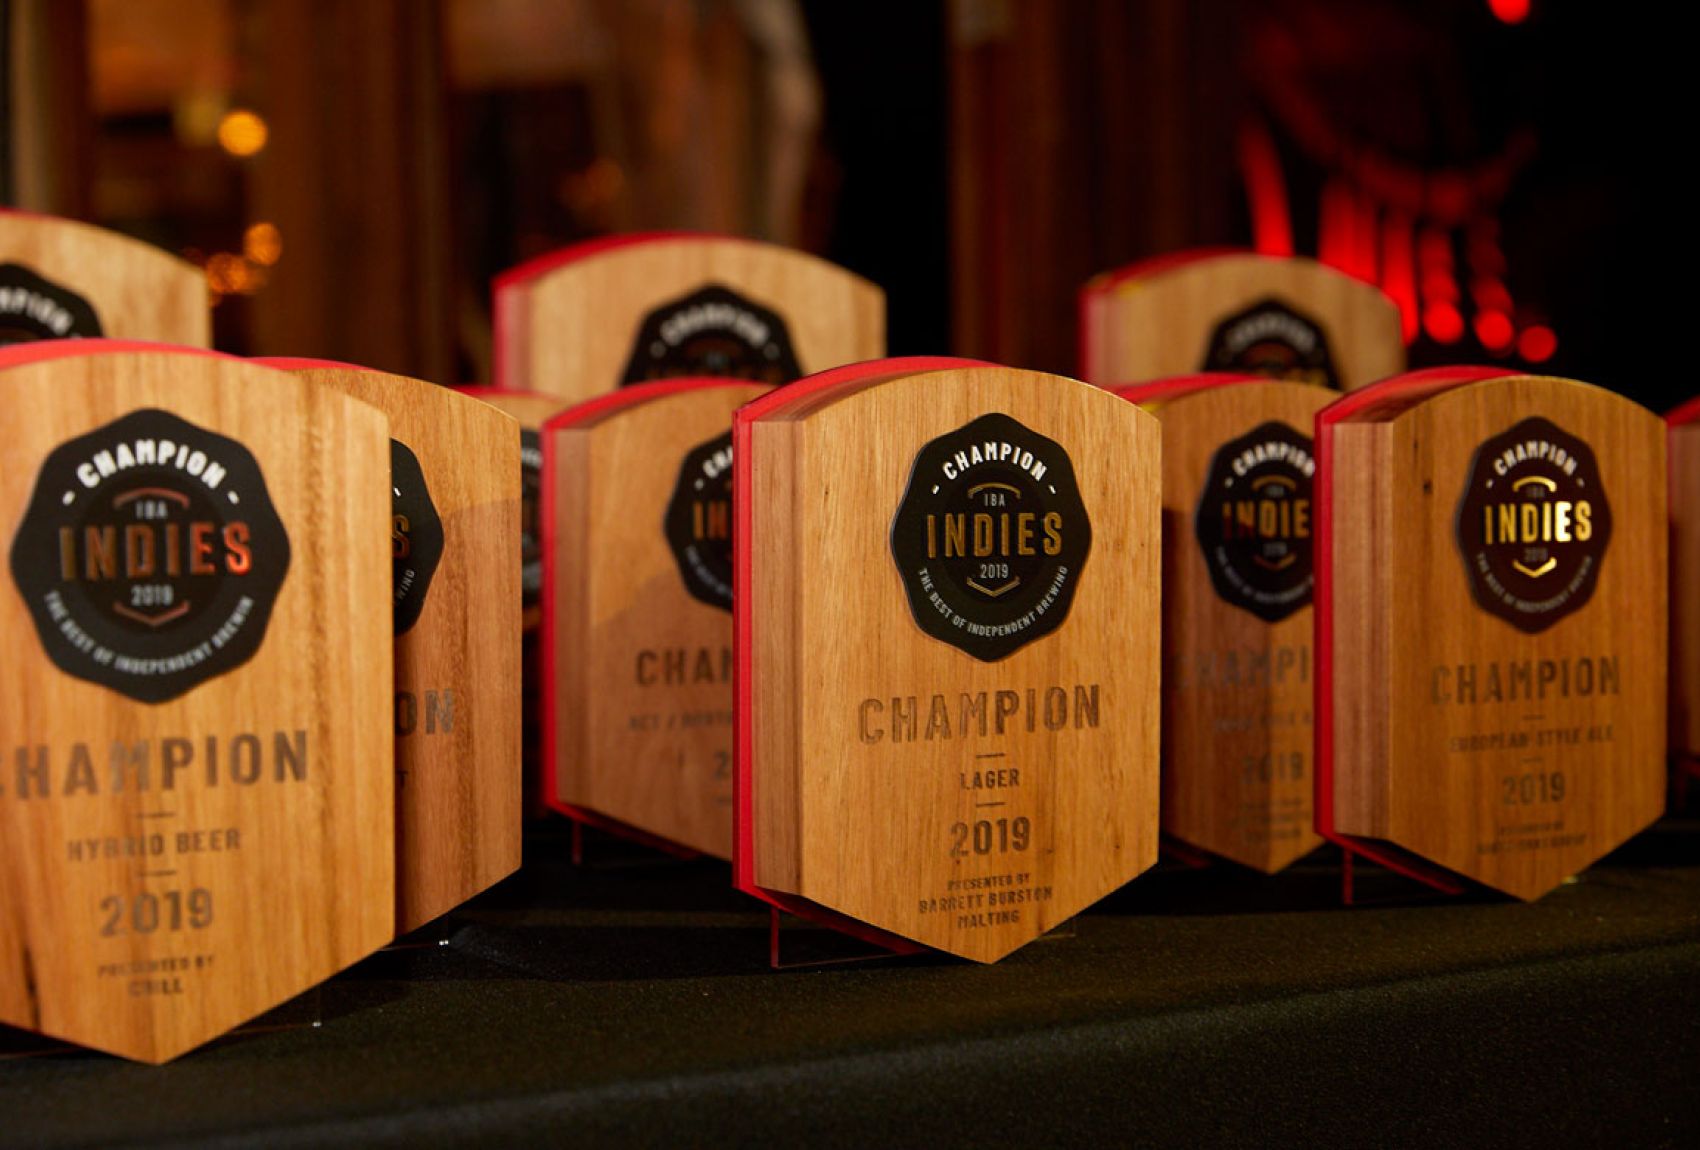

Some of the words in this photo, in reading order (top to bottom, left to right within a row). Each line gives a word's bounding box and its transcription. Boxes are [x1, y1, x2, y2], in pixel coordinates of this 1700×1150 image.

[77, 439, 227, 488] CHAMPION
[942, 441, 1047, 481] CHAMPION
[1494, 440, 1577, 476] CHAMPION
[984, 493, 1005, 507] IBA
[1222, 499, 1311, 540] INDIE
[926, 512, 1062, 558] INDIES
[1484, 500, 1592, 545] INDIES
[59, 521, 251, 581] INDIES
[979, 564, 1009, 579] 2019
[131, 585, 174, 606] 2019
[918, 567, 931, 592] THE
[929, 591, 952, 619] BEST
[953, 614, 967, 628] OF
[967, 612, 1037, 637] INDEPENDENT
[1036, 565, 1069, 616] BREWING
[114, 643, 212, 674] INDEPENDENT
[1431, 655, 1621, 705] CHAMPION
[857, 684, 1100, 744] CHAMPION
[0, 729, 307, 800] HAMPION
[960, 768, 1020, 790] LAGER
[1502, 771, 1566, 805] 2019
[68, 834, 165, 861] HYBRID
[177, 828, 241, 853] BEER
[950, 816, 1031, 857] 2019
[919, 895, 984, 914] BARRETT
[988, 886, 1053, 906] BURSTON
[947, 874, 1013, 891] PRESENTED
[1017, 872, 1030, 883] BY
[100, 888, 213, 938] 2019
[957, 910, 1020, 929] MALTING
